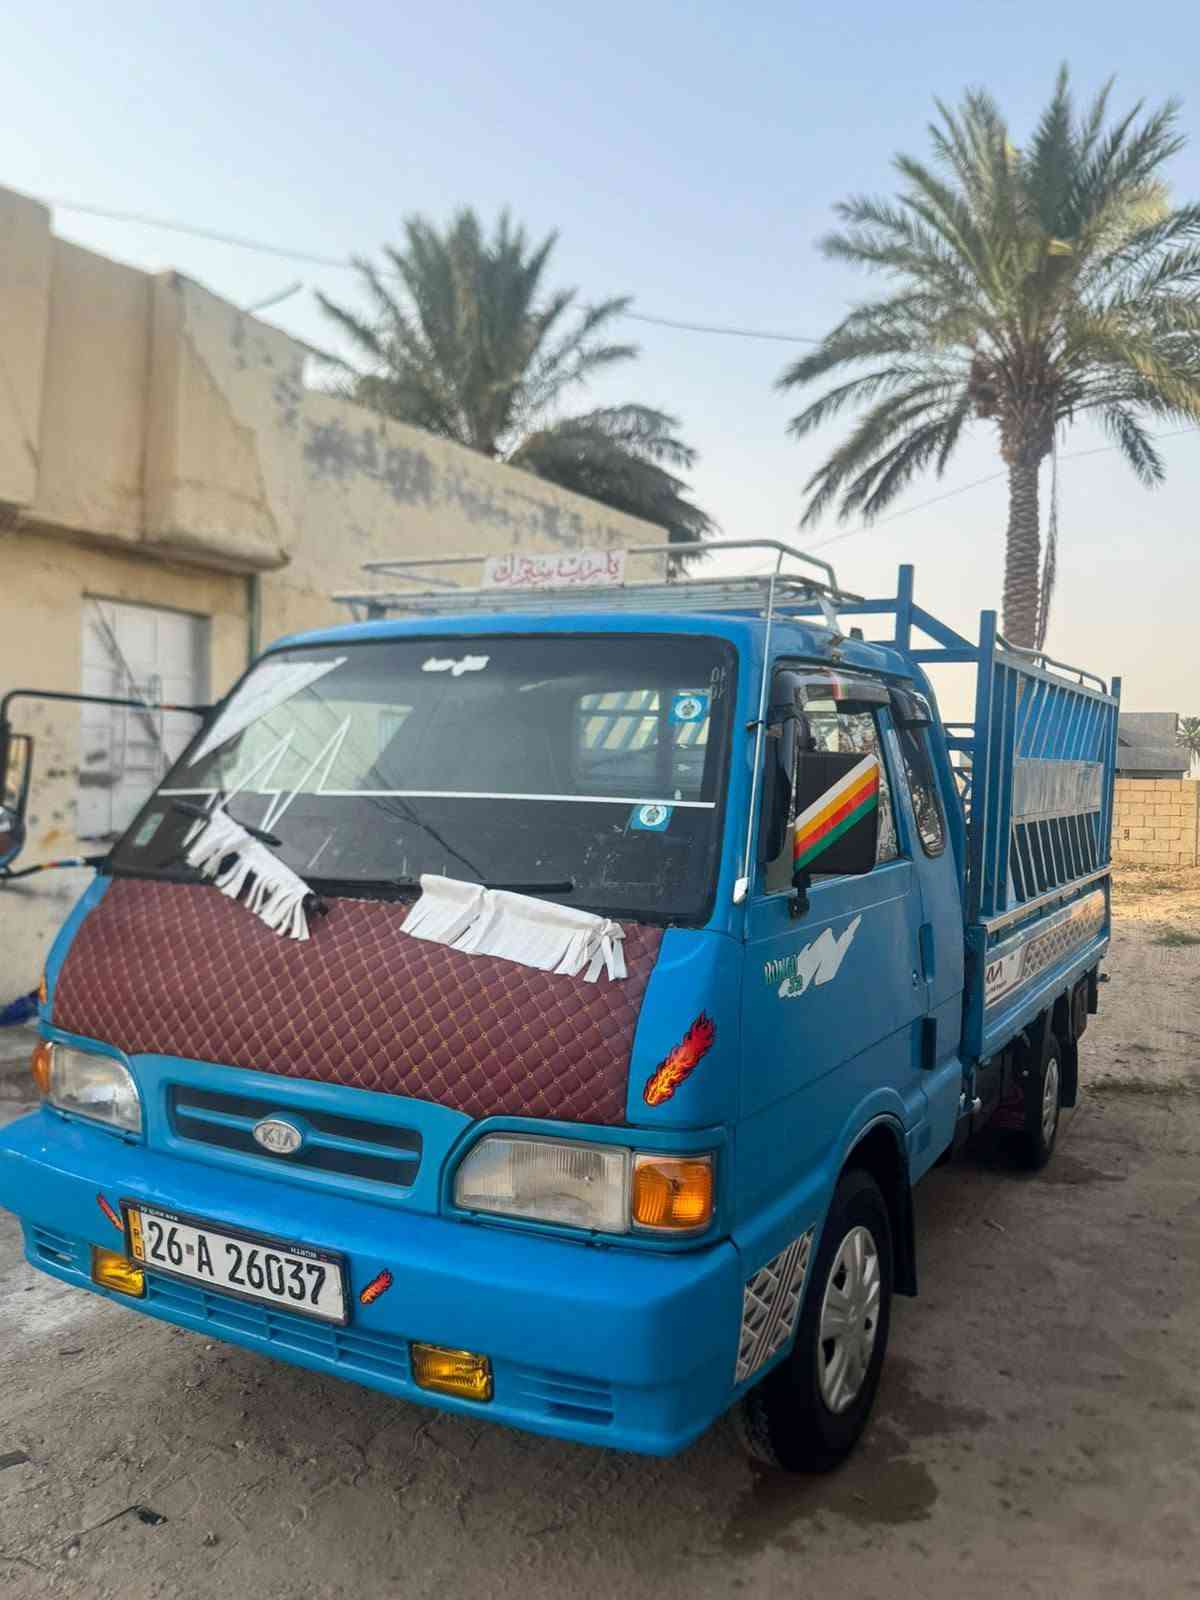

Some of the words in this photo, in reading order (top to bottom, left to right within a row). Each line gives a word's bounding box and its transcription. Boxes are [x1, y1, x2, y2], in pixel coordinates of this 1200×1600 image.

[262, 1125, 296, 1147] KIA
[148, 1220, 183, 1266] 26
[197, 1234, 215, 1277] A
[225, 1242, 327, 1305] 26037
